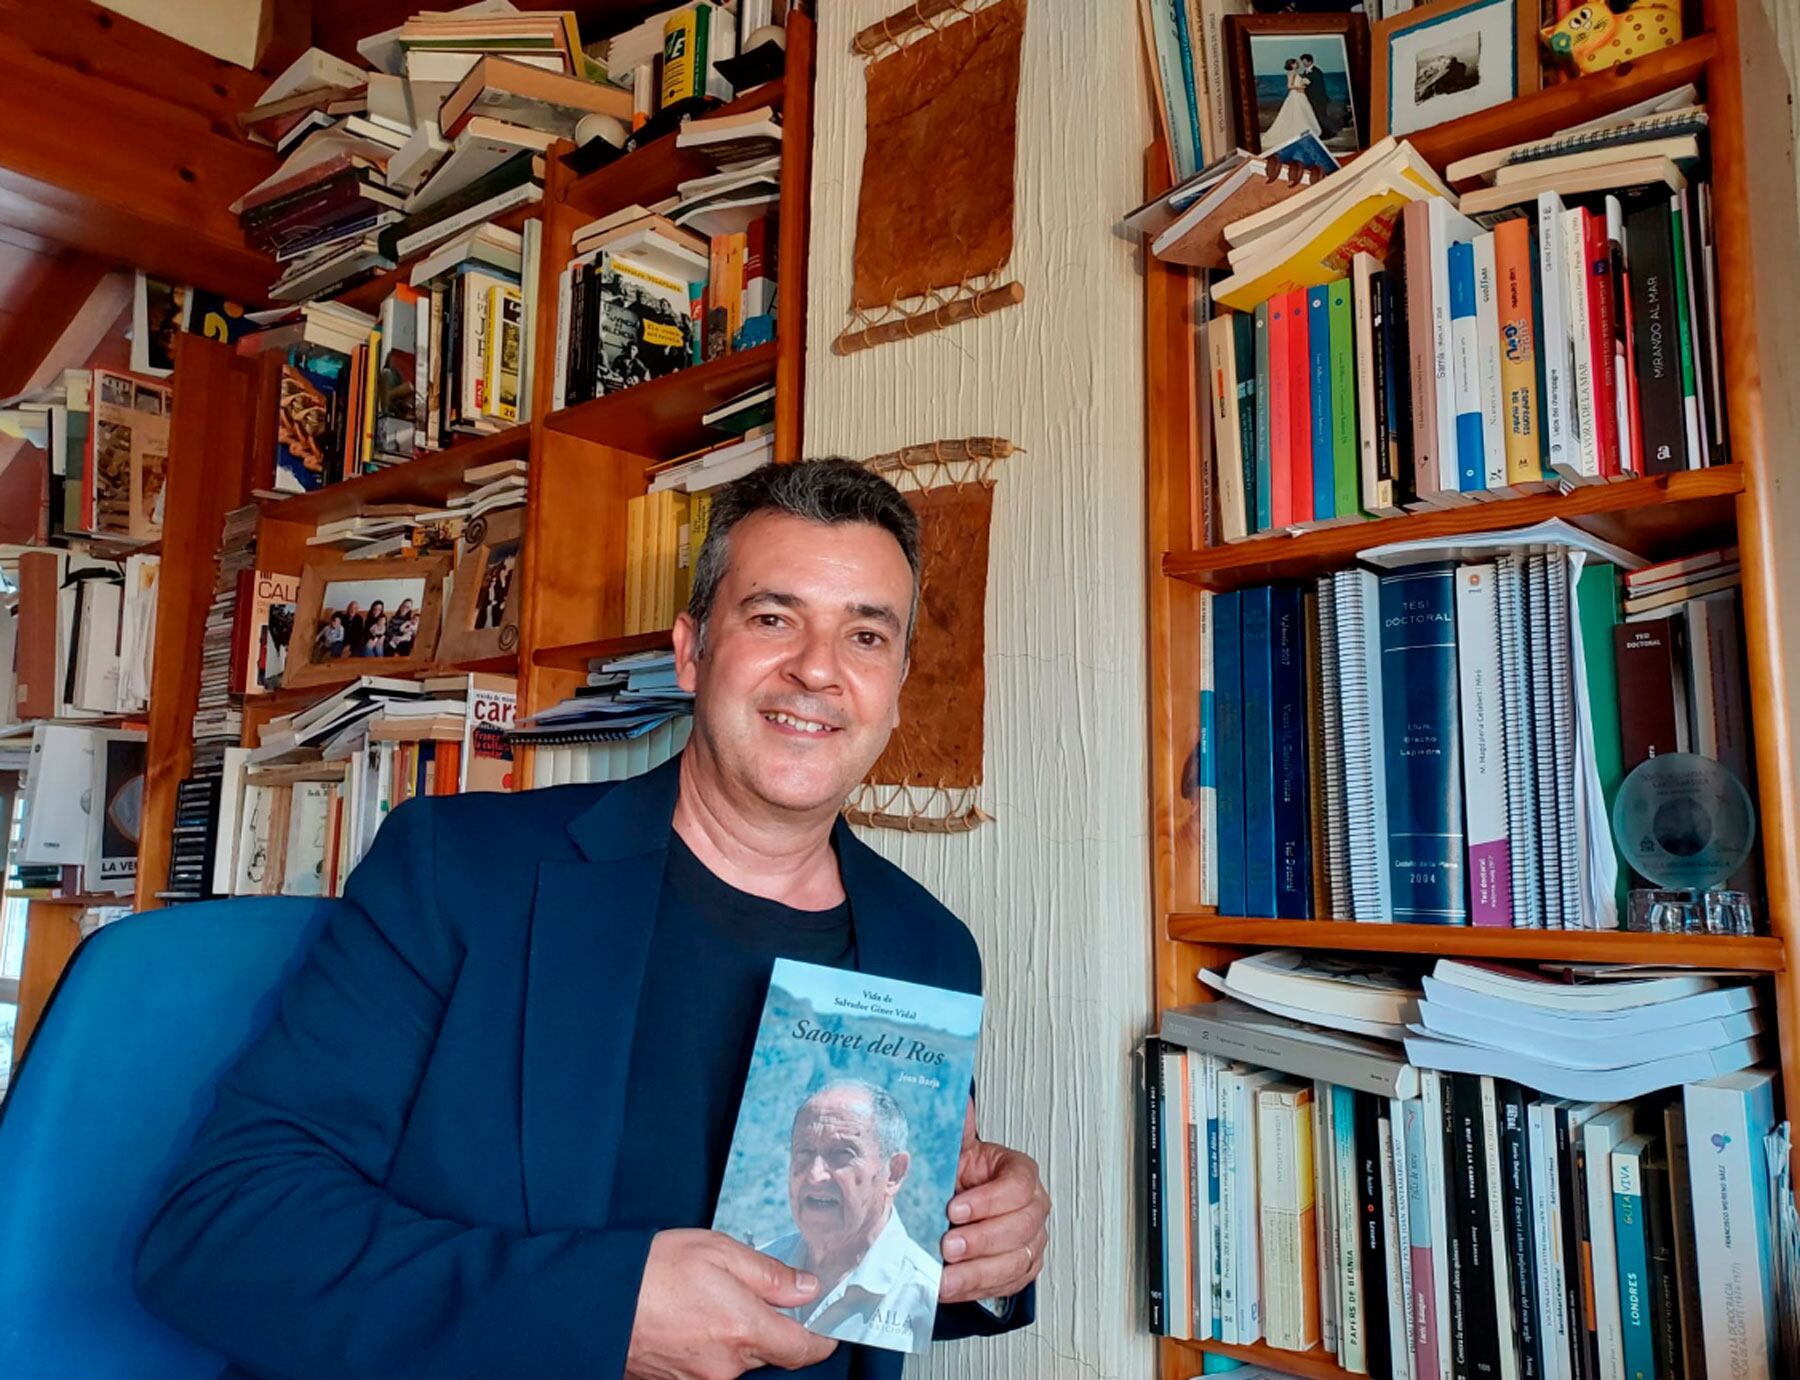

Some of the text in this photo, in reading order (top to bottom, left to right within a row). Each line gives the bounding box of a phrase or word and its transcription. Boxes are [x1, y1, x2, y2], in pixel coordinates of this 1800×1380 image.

[1647, 275, 1664, 378] MIRANDO AL MAR
[1578, 362, 1594, 473] A LA VORA DE LA MAR
[1402, 600, 1429, 611] TESI
[1385, 612, 1452, 628] DOCTORAL
[1626, 639, 1662, 649] DOCTORAL
[1477, 723, 1487, 763] Magdalena
[1478, 763, 1486, 774] M.
[101, 862, 117, 872] LA
[1284, 840, 1297, 892] Tesi Doctoral
[1418, 860, 1427, 868] de
[1409, 873, 1436, 885] 2004
[1478, 858, 1488, 904] Tesi doctoral
[833, 996, 918, 1021] Salvador Giner Vidal
[862, 989, 893, 1004] Vida de
[792, 1019, 947, 1067] Saoret del Ros
[898, 1070, 940, 1088] Joan Borja
[1466, 1143, 1473, 1153] DE
[1467, 1154, 1474, 1164] LA
[1511, 1141, 1520, 1159] Enric
[1365, 1159, 1375, 1173] Paul
[1512, 1160, 1522, 1190] Balaguer
[1366, 1175, 1375, 1196] Auster
[1396, 1158, 1406, 1211] SANTAMARIA
[1467, 1165, 1475, 1199] CAMPANA
[1620, 1165, 1632, 1193] VIVA
[1720, 1182, 1730, 1211] MORENO
[1399, 1212, 1408, 1233] JOAN
[1515, 1205, 1524, 1227] desert
[1722, 1211, 1732, 1249] FRANCISCO
[1452, 1238, 1462, 1270] quimeres
[1453, 1271, 1462, 1289] altres
[1517, 1252, 1527, 1295] palpitacions
[1346, 1249, 1358, 1346] PAPERS DE BERNIA
[1628, 1272, 1641, 1327] LONDRES
[1723, 1282, 1737, 1336] DEMOCRACIA
[1454, 1293, 1464, 1331] modernitat
[1522, 1324, 1532, 1343] segle
[1736, 1307, 1747, 1347] ALICANTE
[1455, 1339, 1465, 1364] Contra
[1727, 1337, 1738, 1349] LA
